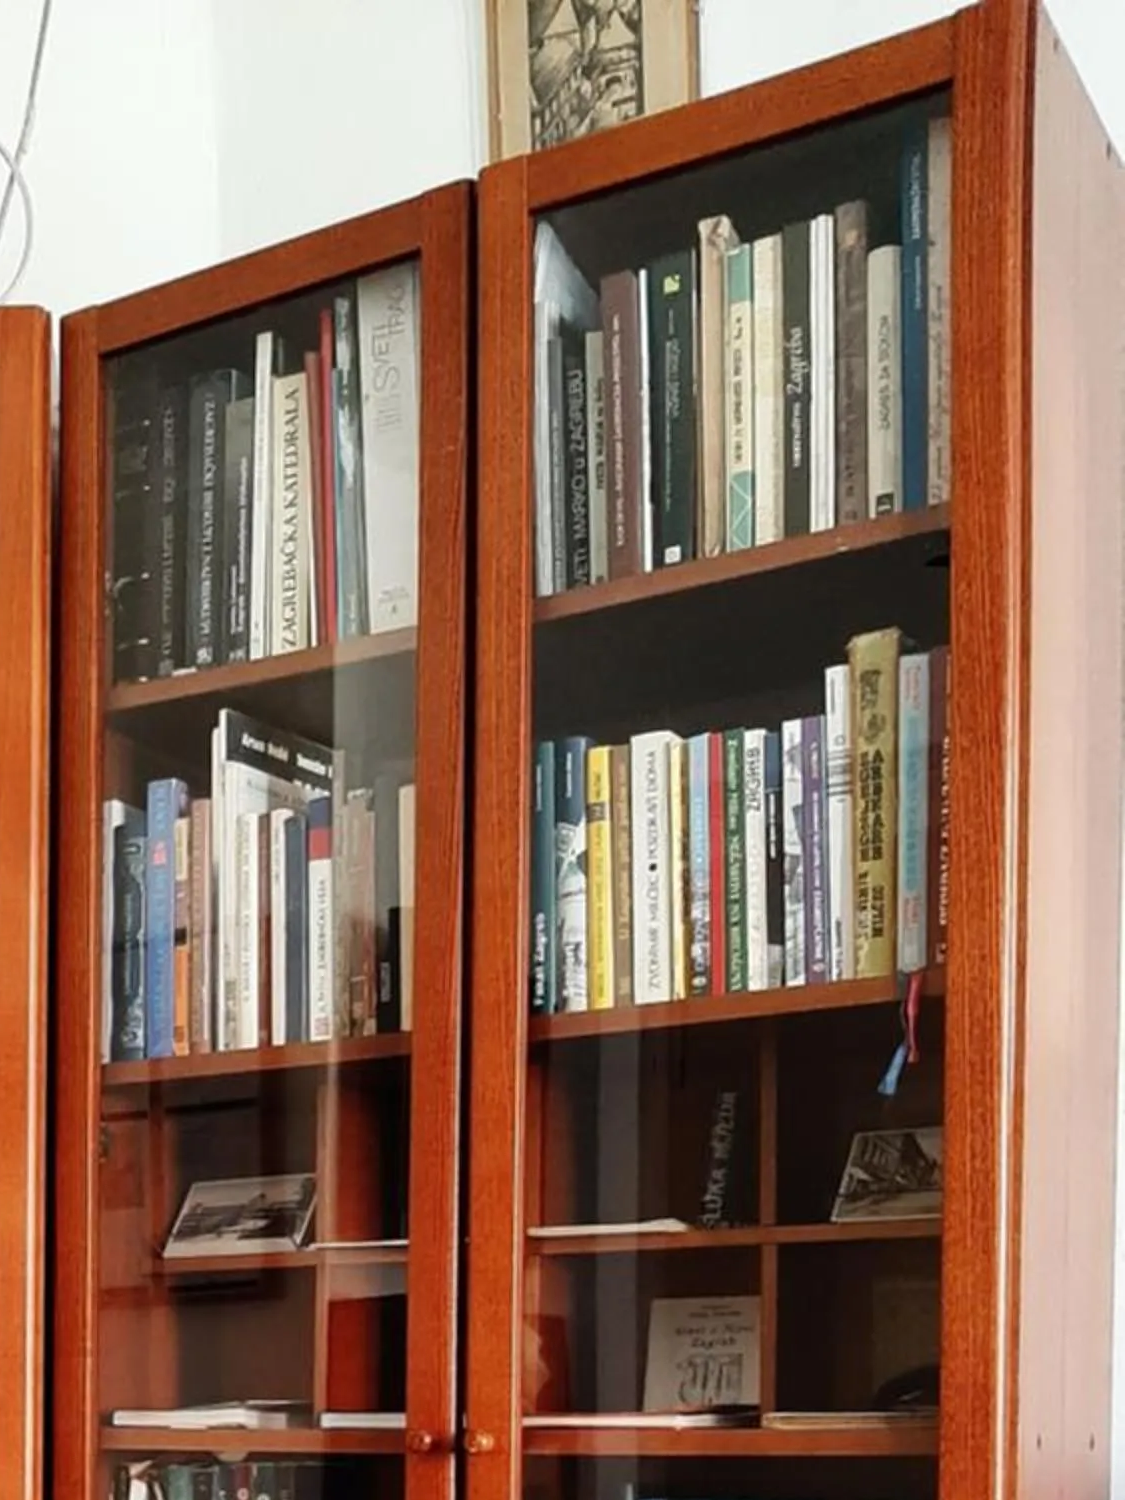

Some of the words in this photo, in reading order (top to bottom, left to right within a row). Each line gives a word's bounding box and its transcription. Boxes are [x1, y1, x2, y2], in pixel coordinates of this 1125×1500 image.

[280, 386, 300, 508] KATEDRALA
[280, 511, 300, 650] ZAGREBAČKA
[574, 547, 588, 584] VETI
[534, 912, 548, 963] Zagreb
